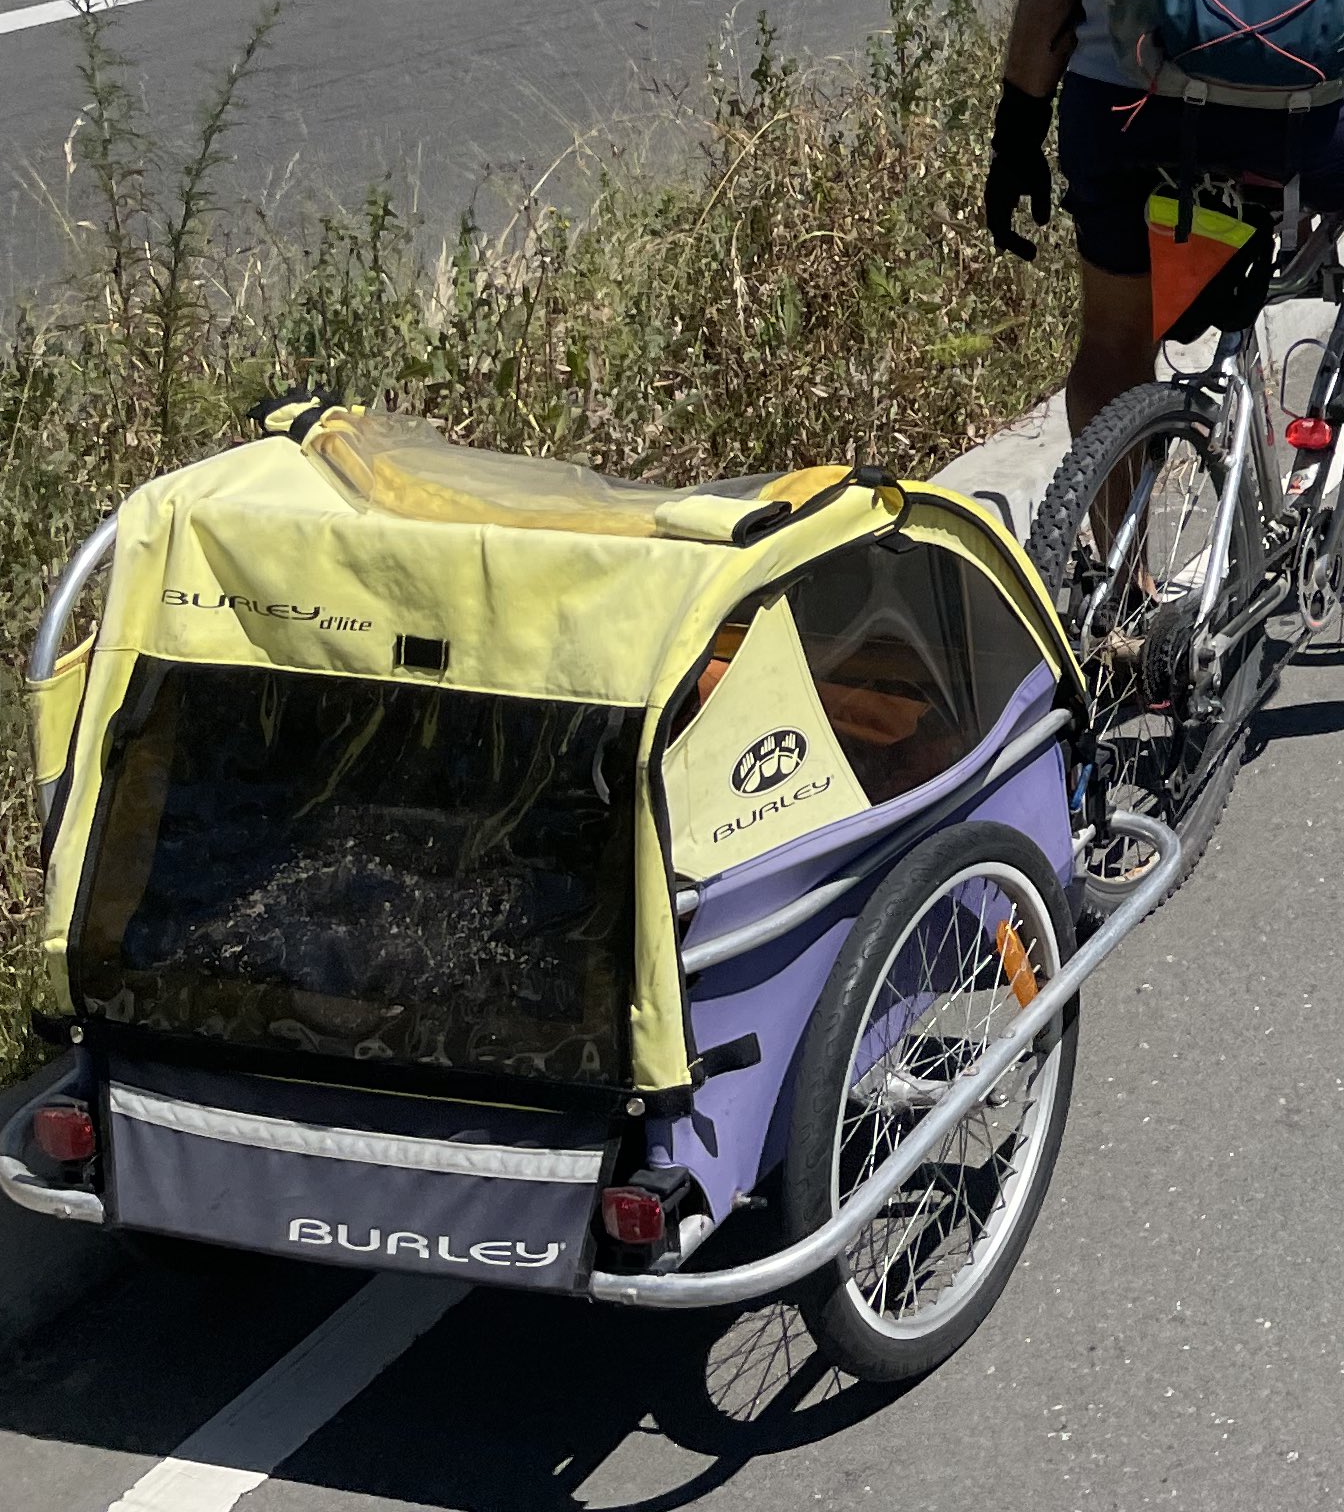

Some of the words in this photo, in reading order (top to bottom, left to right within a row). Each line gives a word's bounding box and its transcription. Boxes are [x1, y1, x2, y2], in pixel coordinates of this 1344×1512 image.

[161, 588, 321, 621] BURLEY
[319, 617, 373, 633] d'lite
[712, 776, 831, 844] BURLEY
[288, 1218, 560, 1267] BURLEY
